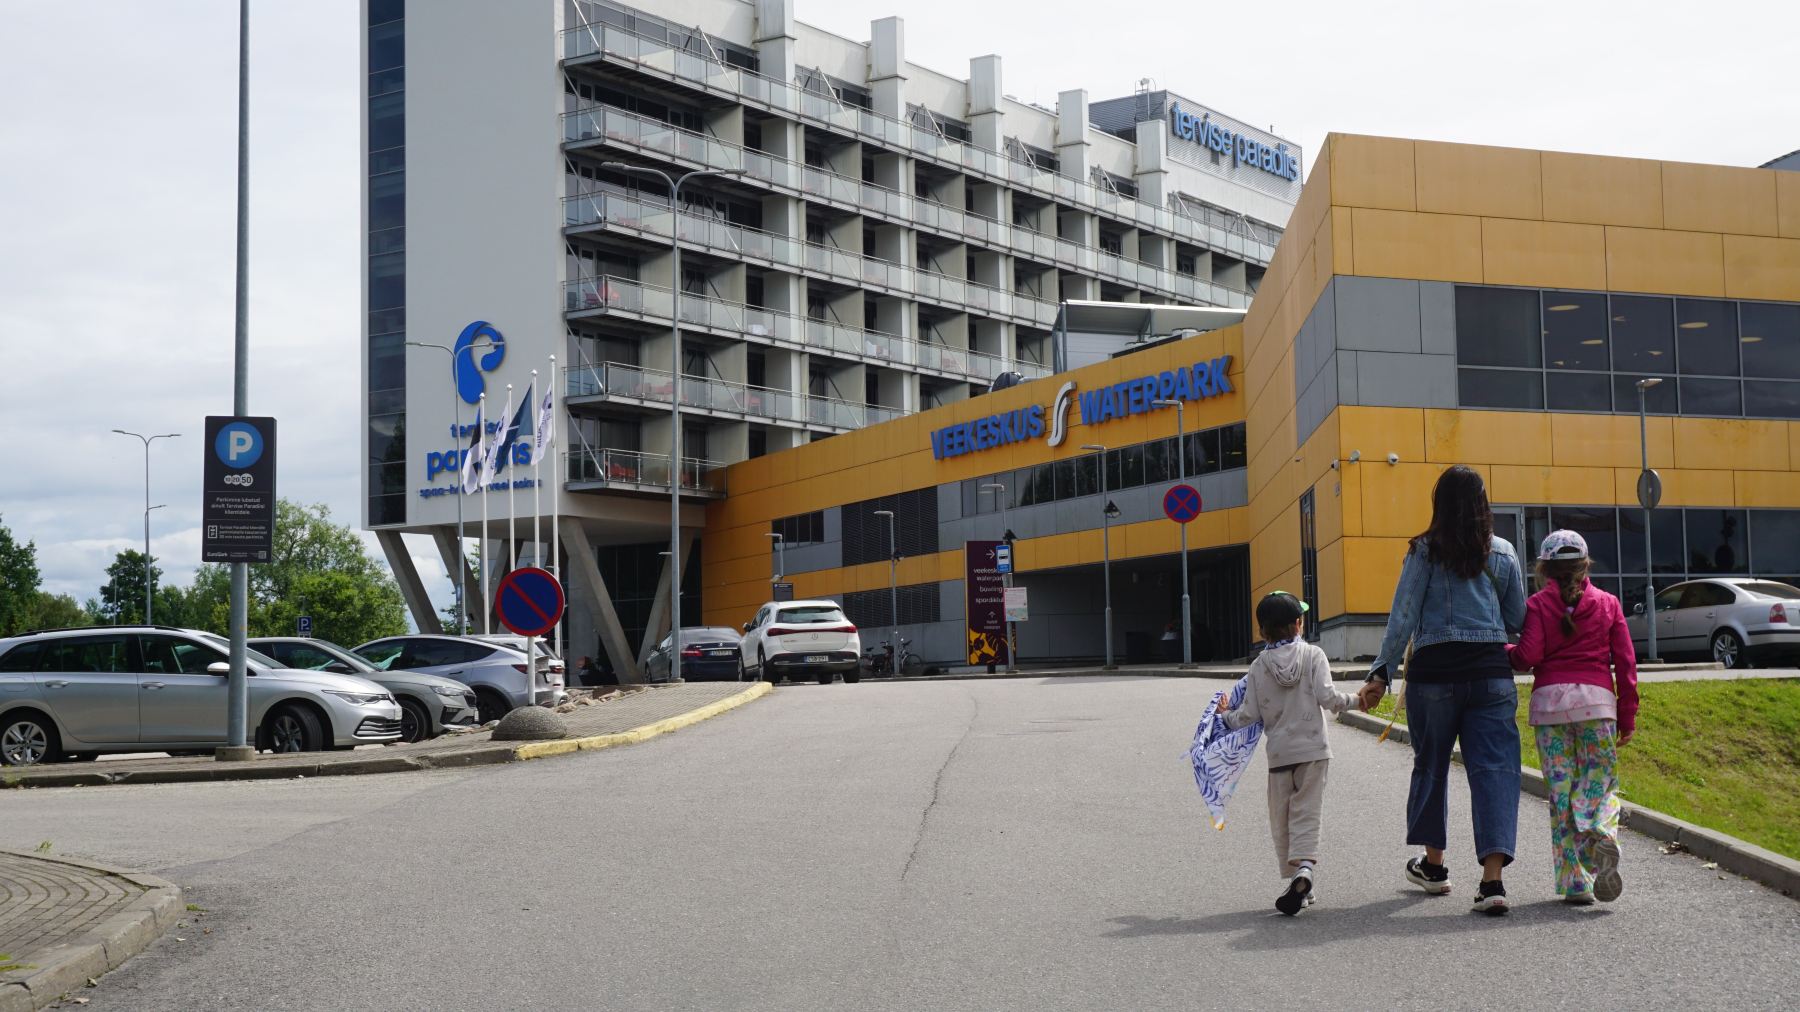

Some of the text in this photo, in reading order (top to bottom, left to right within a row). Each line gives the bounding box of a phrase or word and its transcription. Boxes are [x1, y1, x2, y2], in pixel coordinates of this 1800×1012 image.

[1171, 100, 1298, 181] tervise paradiis
[930, 354, 1233, 460] VEEKESKUS WATERPARK
[229, 431, 253, 461] P
[241, 476, 252, 484] 50
